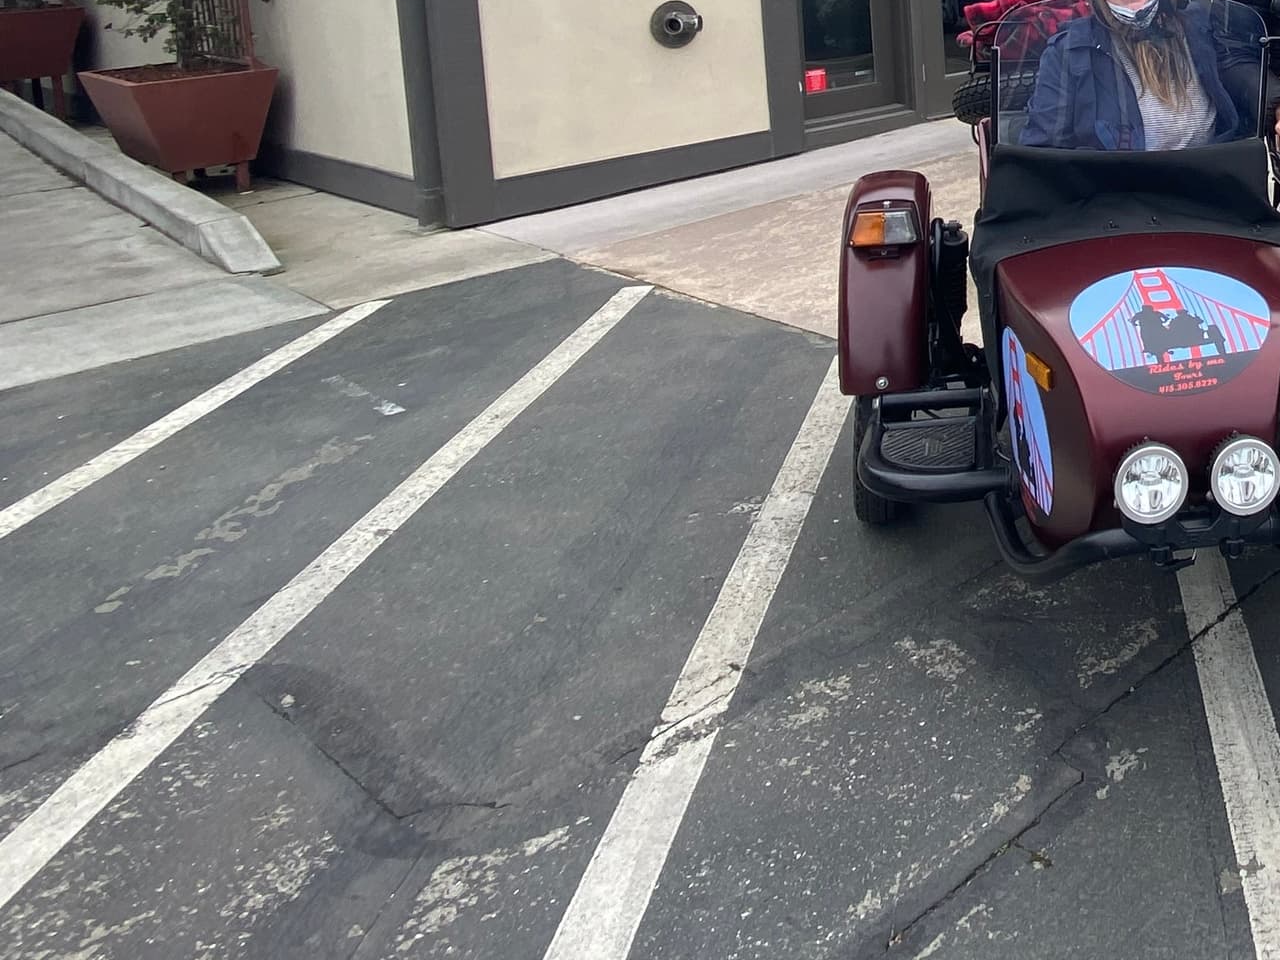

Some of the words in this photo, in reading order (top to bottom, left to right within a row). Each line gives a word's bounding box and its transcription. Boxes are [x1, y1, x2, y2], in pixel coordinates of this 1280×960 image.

[1149, 364, 1184, 374] Rides
[1188, 361, 1202, 369] by
[1173, 371, 1203, 381] Tours
